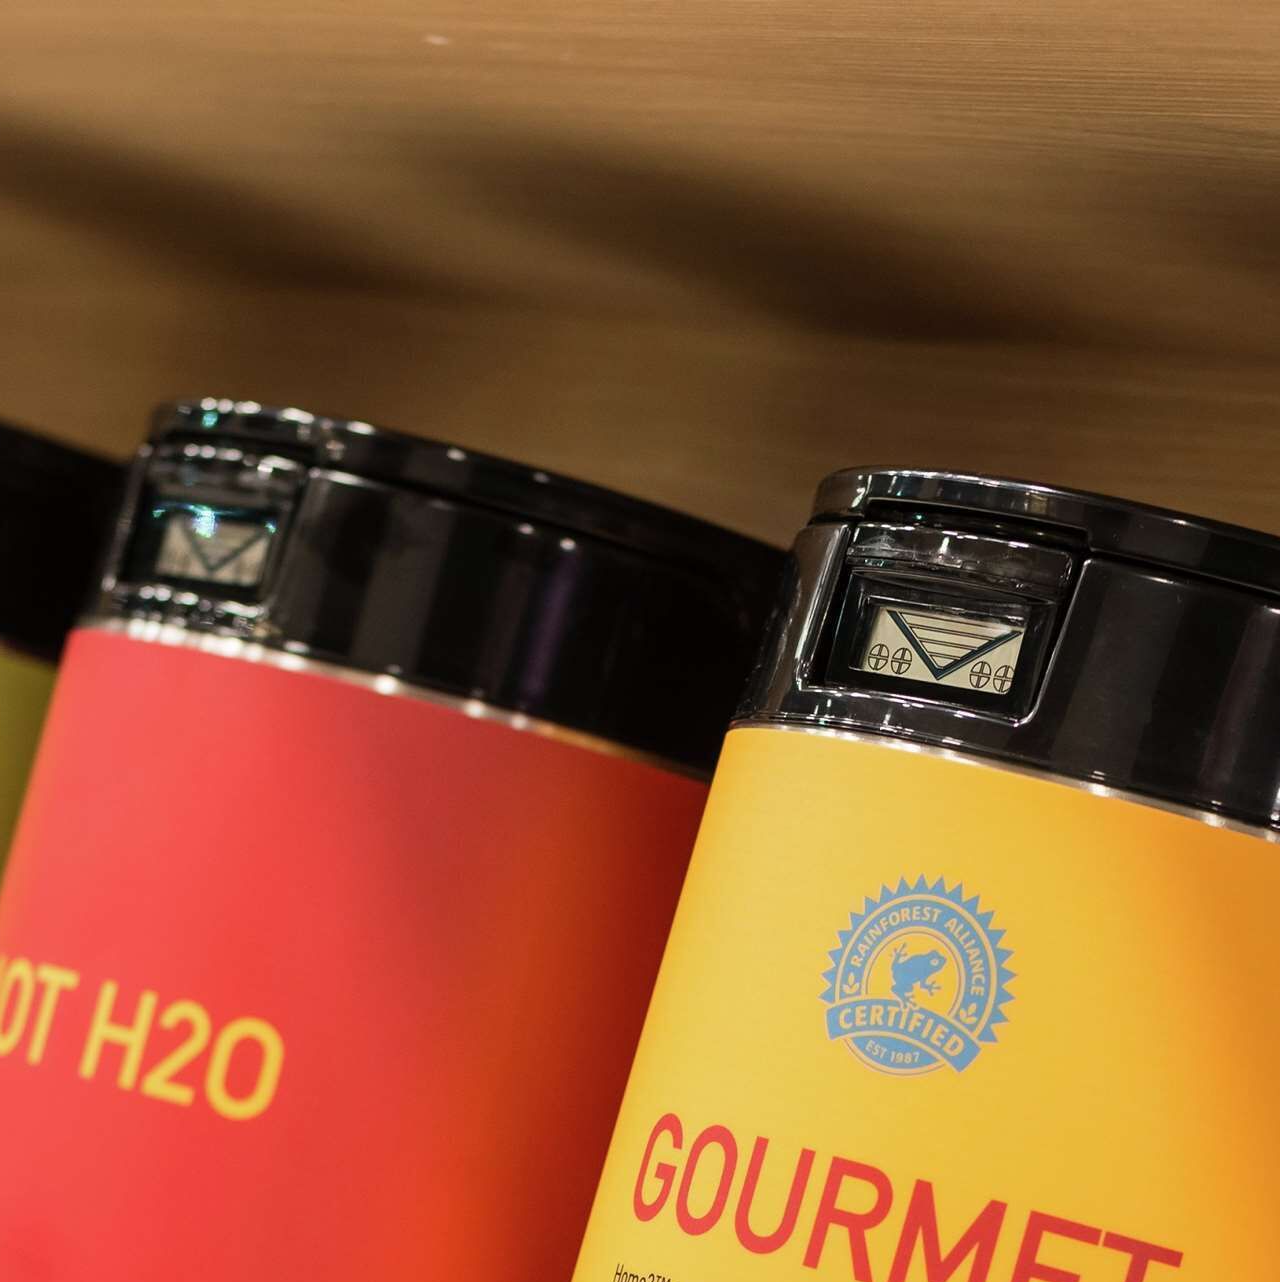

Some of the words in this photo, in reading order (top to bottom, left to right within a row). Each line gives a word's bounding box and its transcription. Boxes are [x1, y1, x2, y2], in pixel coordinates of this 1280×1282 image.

[850, 905, 942, 968] RAINFOREST
[944, 916, 986, 997] ALLIANCE
[79, 980, 284, 1120] H2O
[838, 1003, 965, 1057] CERTIFIED
[865, 1039, 888, 1059] EST
[889, 1050, 920, 1064] 1987
